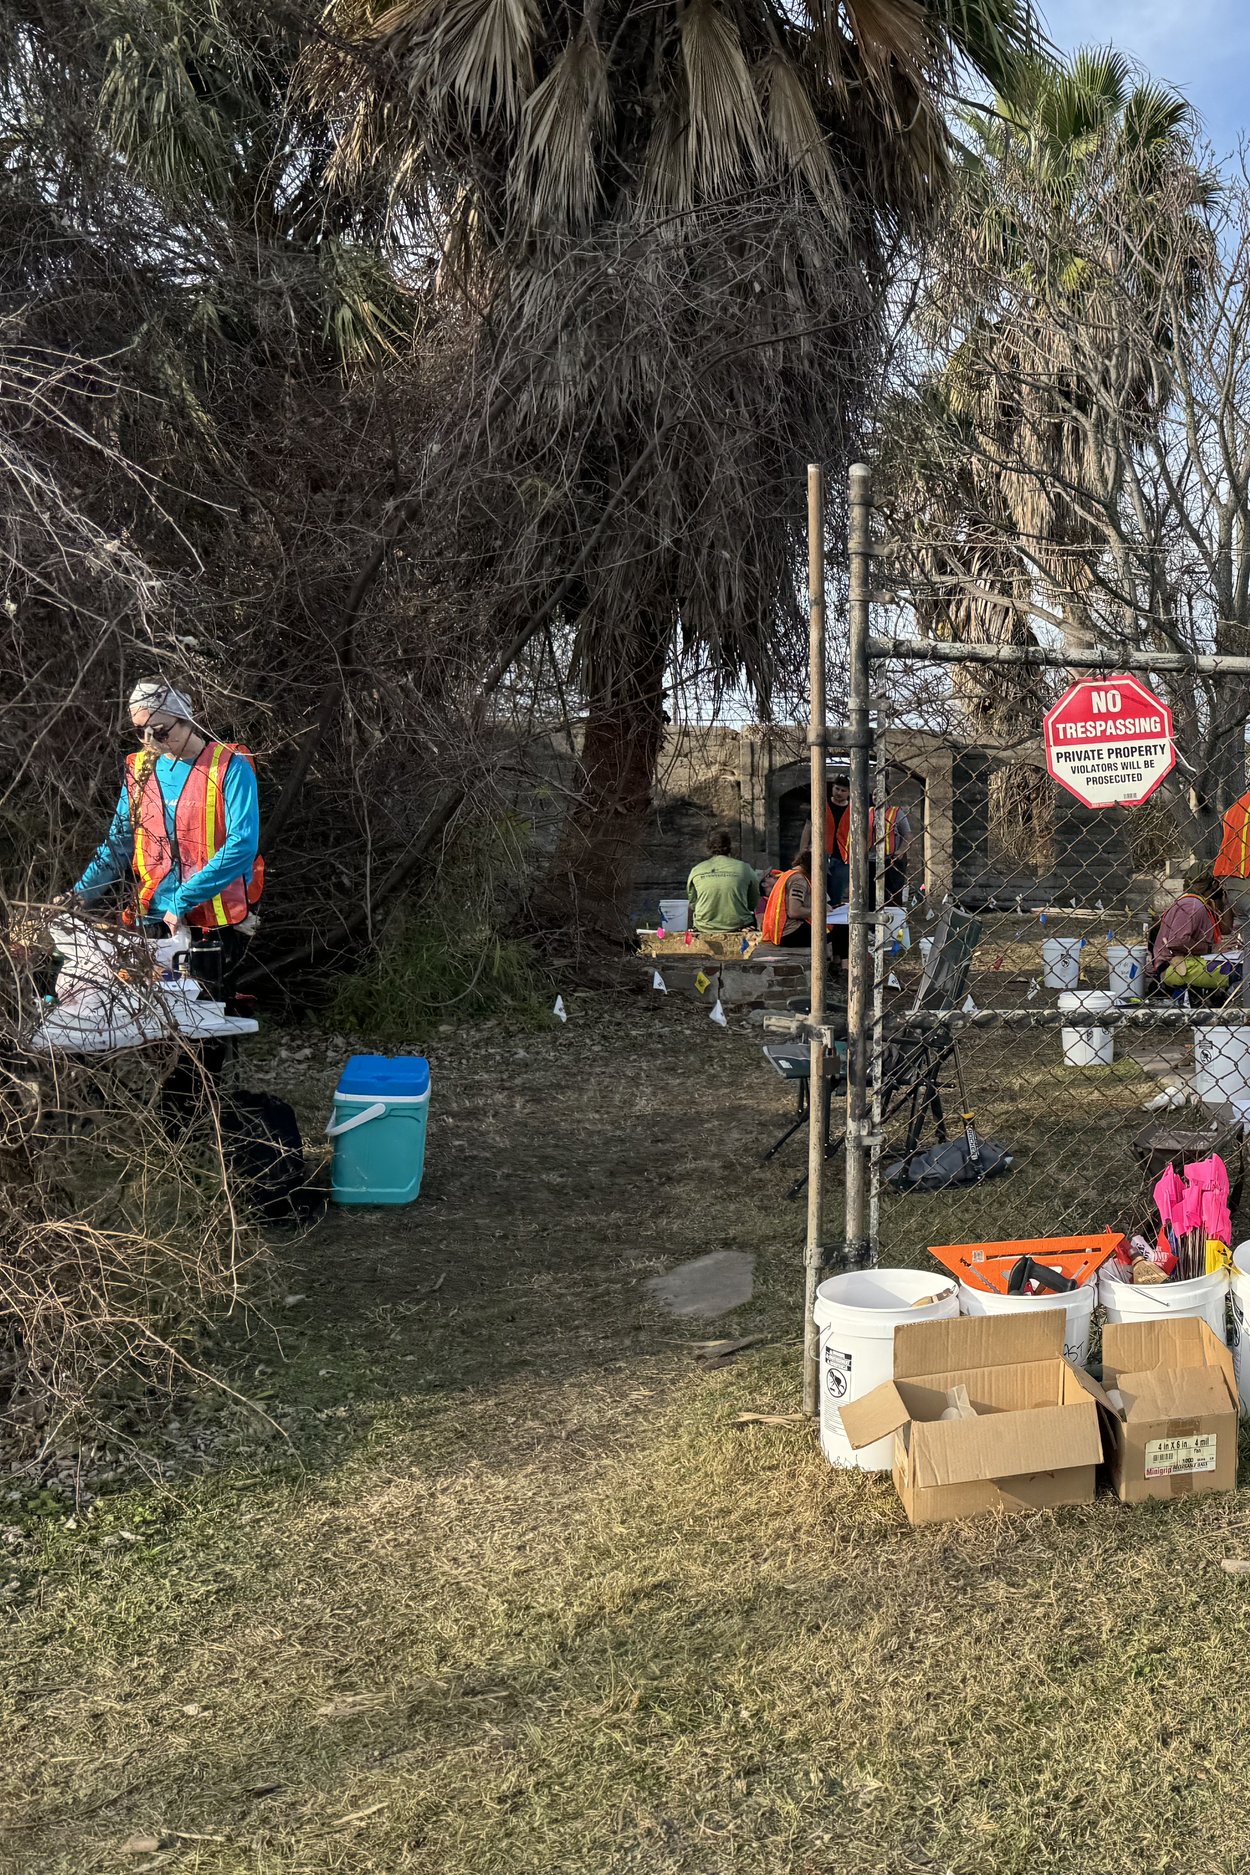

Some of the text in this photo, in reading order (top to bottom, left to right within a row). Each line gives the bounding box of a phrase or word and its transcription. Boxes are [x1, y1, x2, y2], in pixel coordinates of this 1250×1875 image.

[1091, 690, 1122, 714] NO
[1056, 716, 1161, 740] TRESPASSING
[1056, 744, 1166, 763] PRIVATE PROPERTY
[1070, 759, 1155, 775] VIOLATORS WILL BE
[1086, 773, 1143, 786] PROSECUTED
[1163, 1442, 1170, 1450] in
[1146, 1466, 1172, 1476] Minigrip
